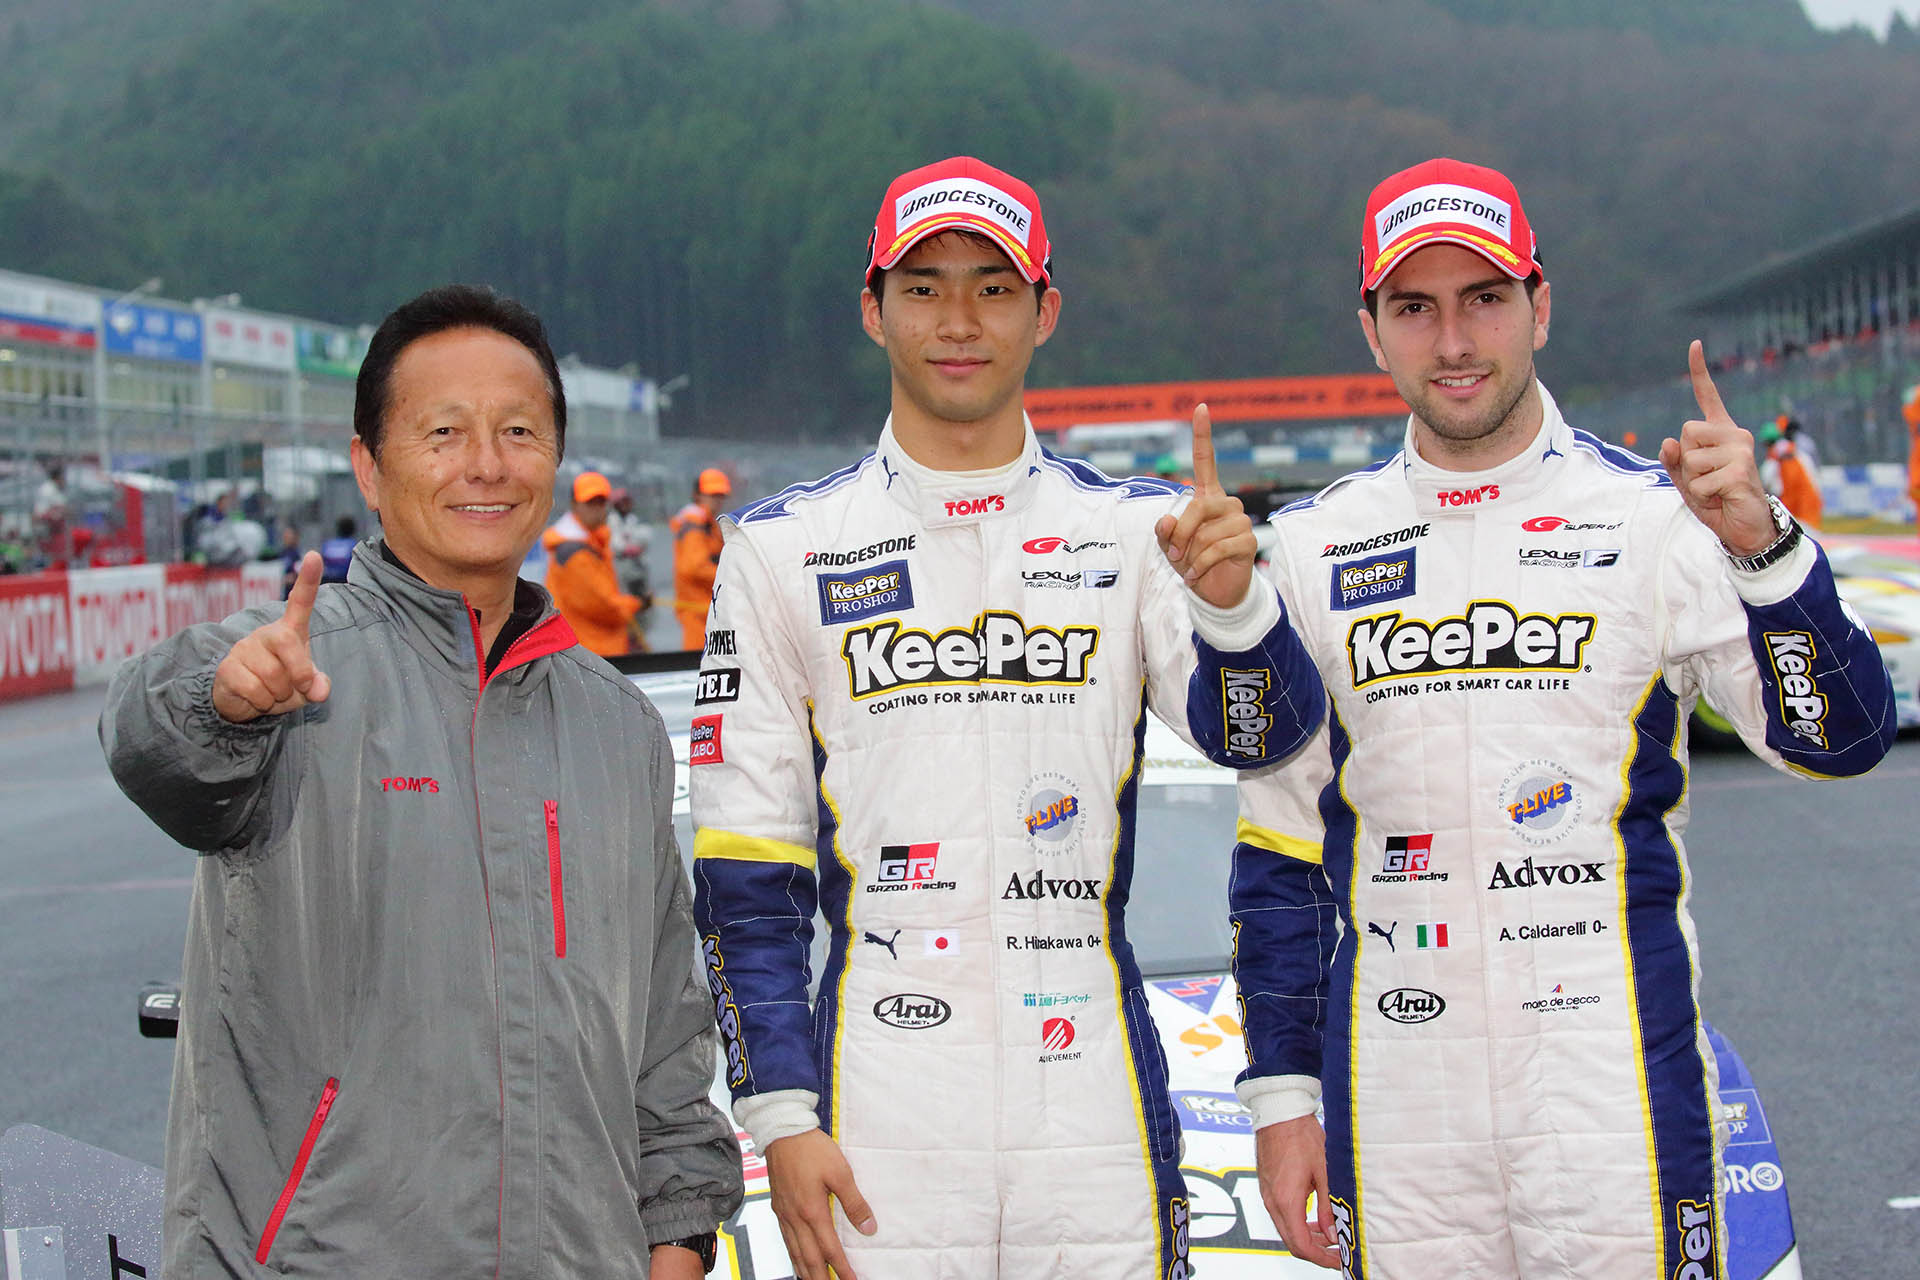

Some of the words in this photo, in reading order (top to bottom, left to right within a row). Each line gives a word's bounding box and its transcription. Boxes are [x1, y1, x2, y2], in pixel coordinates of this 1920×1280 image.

[901, 190, 1028, 232] BRIDGESTONE
[1382, 197, 1507, 238] BRIDGESTONE
[944, 495, 1005, 516] TOM'S
[1437, 484, 1500, 507] TOM'S
[803, 534, 916, 568] BRIDGESTONE
[1320, 523, 1431, 558] BRIDGESTONE
[1519, 548, 1581, 561] LEXUS
[829, 574, 899, 600] KeePer
[1021, 571, 1082, 583] LEXUS
[1342, 562, 1405, 588] KeePer
[833, 600, 862, 614] PRO
[863, 590, 899, 609] SHOP
[1343, 586, 1369, 602] PRO
[1370, 579, 1404, 595] SHOP
[0, 594, 70, 677] YOTA
[1350, 602, 1594, 687] KeePer
[845, 613, 1097, 697] KeePer
[869, 694, 928, 716] COATING
[934, 692, 962, 706] FOR
[1021, 693, 1044, 705] CAR
[1049, 692, 1076, 705] LIFE
[1366, 684, 1420, 704] COATING
[1426, 680, 1451, 694] FOR
[1457, 678, 1501, 692] SMART
[1506, 679, 1533, 691] CAR
[1539, 678, 1570, 691] LIFE
[1225, 670, 1268, 758] KeePer
[381, 776, 440, 793] TOM'S
[1025, 795, 1079, 836] T-LIVE
[1506, 781, 1572, 824] T-LIVE
[878, 856, 936, 882] GR
[1384, 847, 1429, 872] GR
[1001, 869, 1101, 900] Advox
[1488, 856, 1607, 890] Advox
[1006, 935, 1023, 950] R.
[1499, 927, 1516, 942] A.
[1519, 920, 1587, 940] Caldarelli
[880, 996, 943, 1020] Arai
[1383, 991, 1437, 1014] Arai
